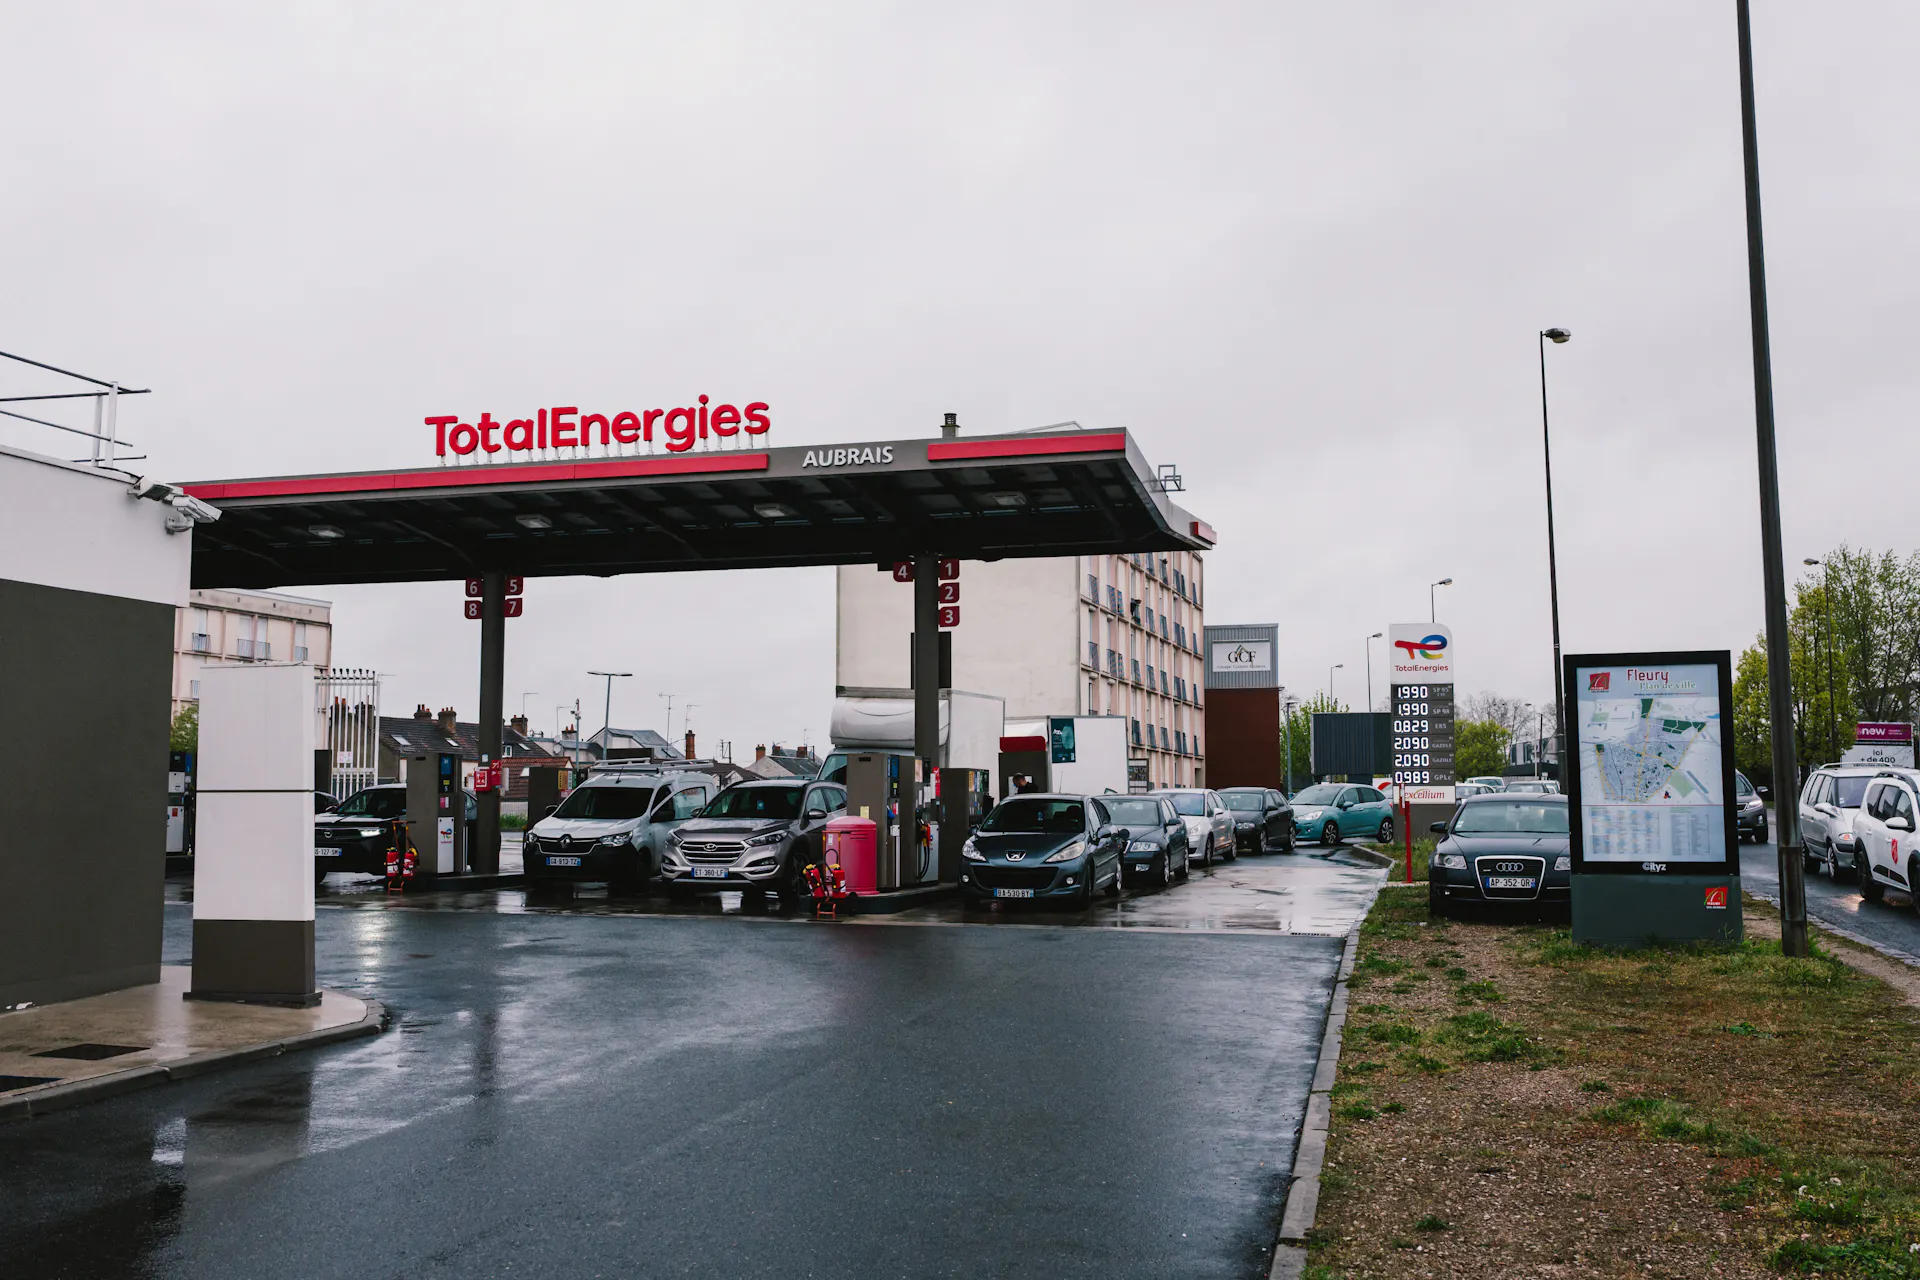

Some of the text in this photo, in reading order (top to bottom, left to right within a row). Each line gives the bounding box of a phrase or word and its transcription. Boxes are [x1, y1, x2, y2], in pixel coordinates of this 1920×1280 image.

[425, 394, 770, 456] TotalEnergies
[802, 446, 893, 468] AUBRAIS
[898, 564, 908, 579] 4
[945, 562, 952, 577] 1
[470, 581, 478, 595] 6
[509, 579, 518, 593] 5
[944, 585, 954, 600] 2
[468, 603, 478, 617] 8
[508, 600, 517, 615] 7
[944, 609, 954, 624] 3
[1227, 650, 1257, 664] GCF
[1394, 663, 1449, 673] TotalEnergies
[1626, 669, 1669, 684] Fleury
[1640, 680, 1697, 690] Plan de ville
[1879, 756, 1896, 764] 400
[1404, 789, 1445, 799] excellium
[1642, 862, 1667, 872] Cityz
